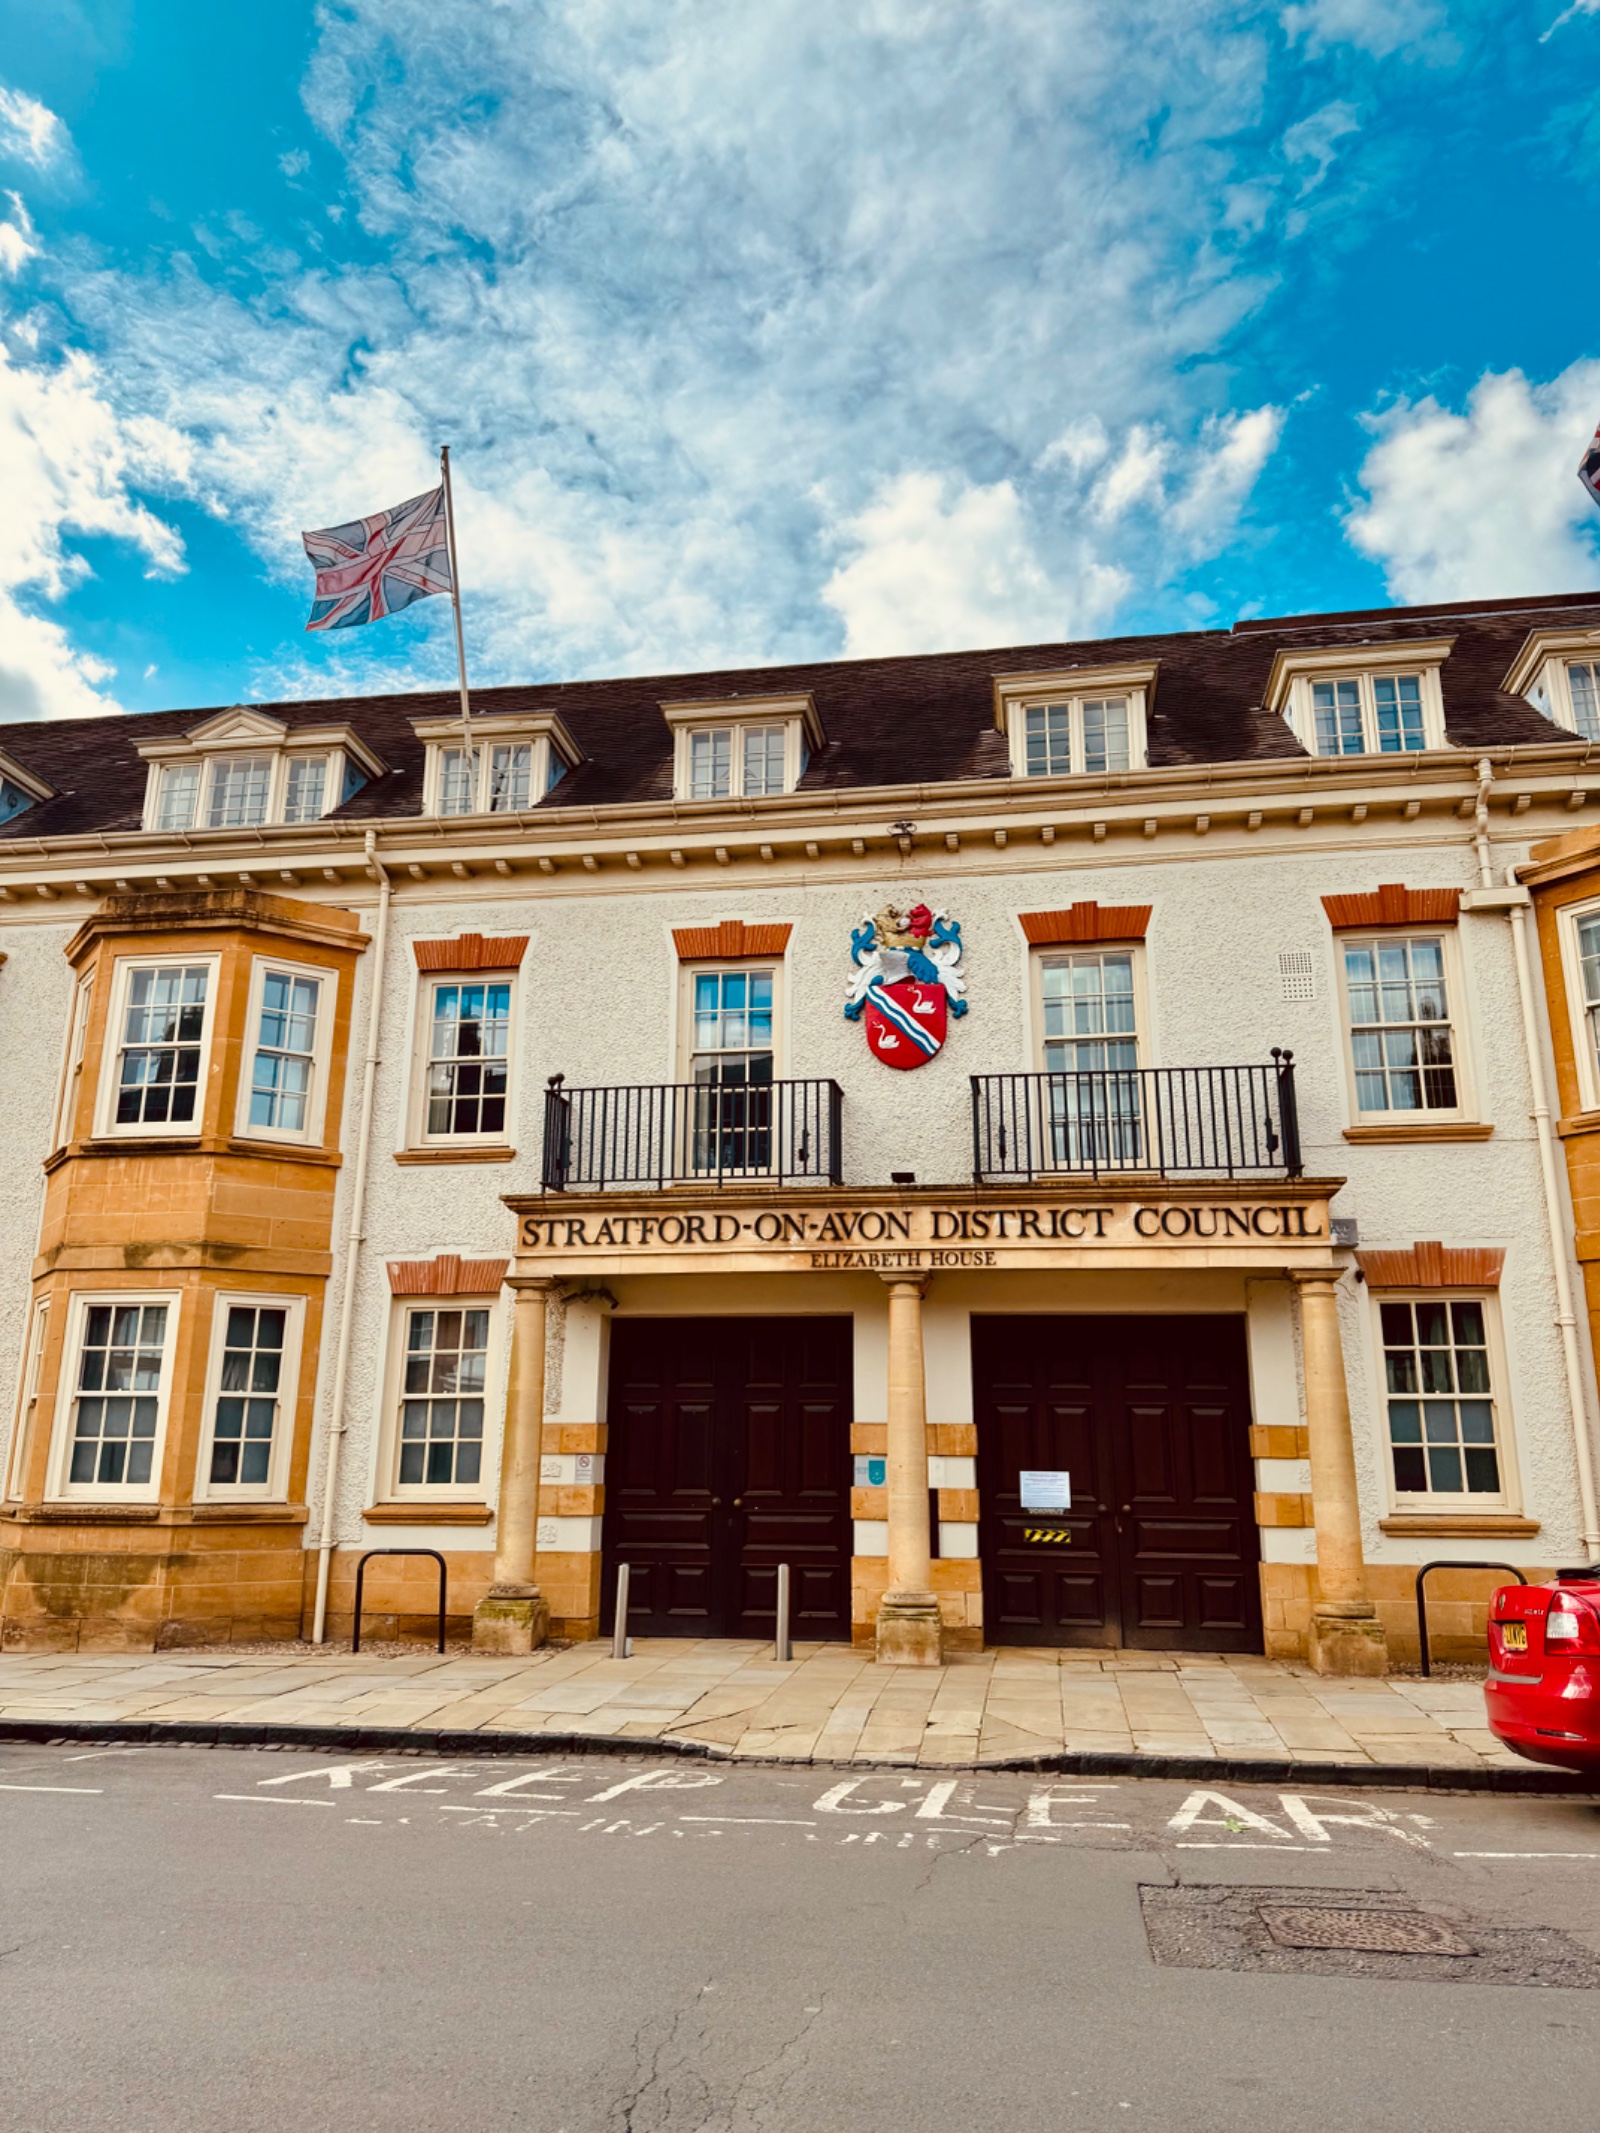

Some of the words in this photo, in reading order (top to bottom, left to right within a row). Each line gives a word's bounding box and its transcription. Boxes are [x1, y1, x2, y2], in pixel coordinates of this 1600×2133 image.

[522, 1211, 912, 1247] STRATFORD-ON-AVON
[930, 1208, 1114, 1239] DISTRICT
[1134, 1206, 1322, 1237] COUNCIL
[810, 1252, 921, 1268] ELIZABETH
[930, 1251, 997, 1266] HOUSE
[257, 1760, 726, 1802] KEEP
[812, 1774, 1436, 1848] CLEAR
